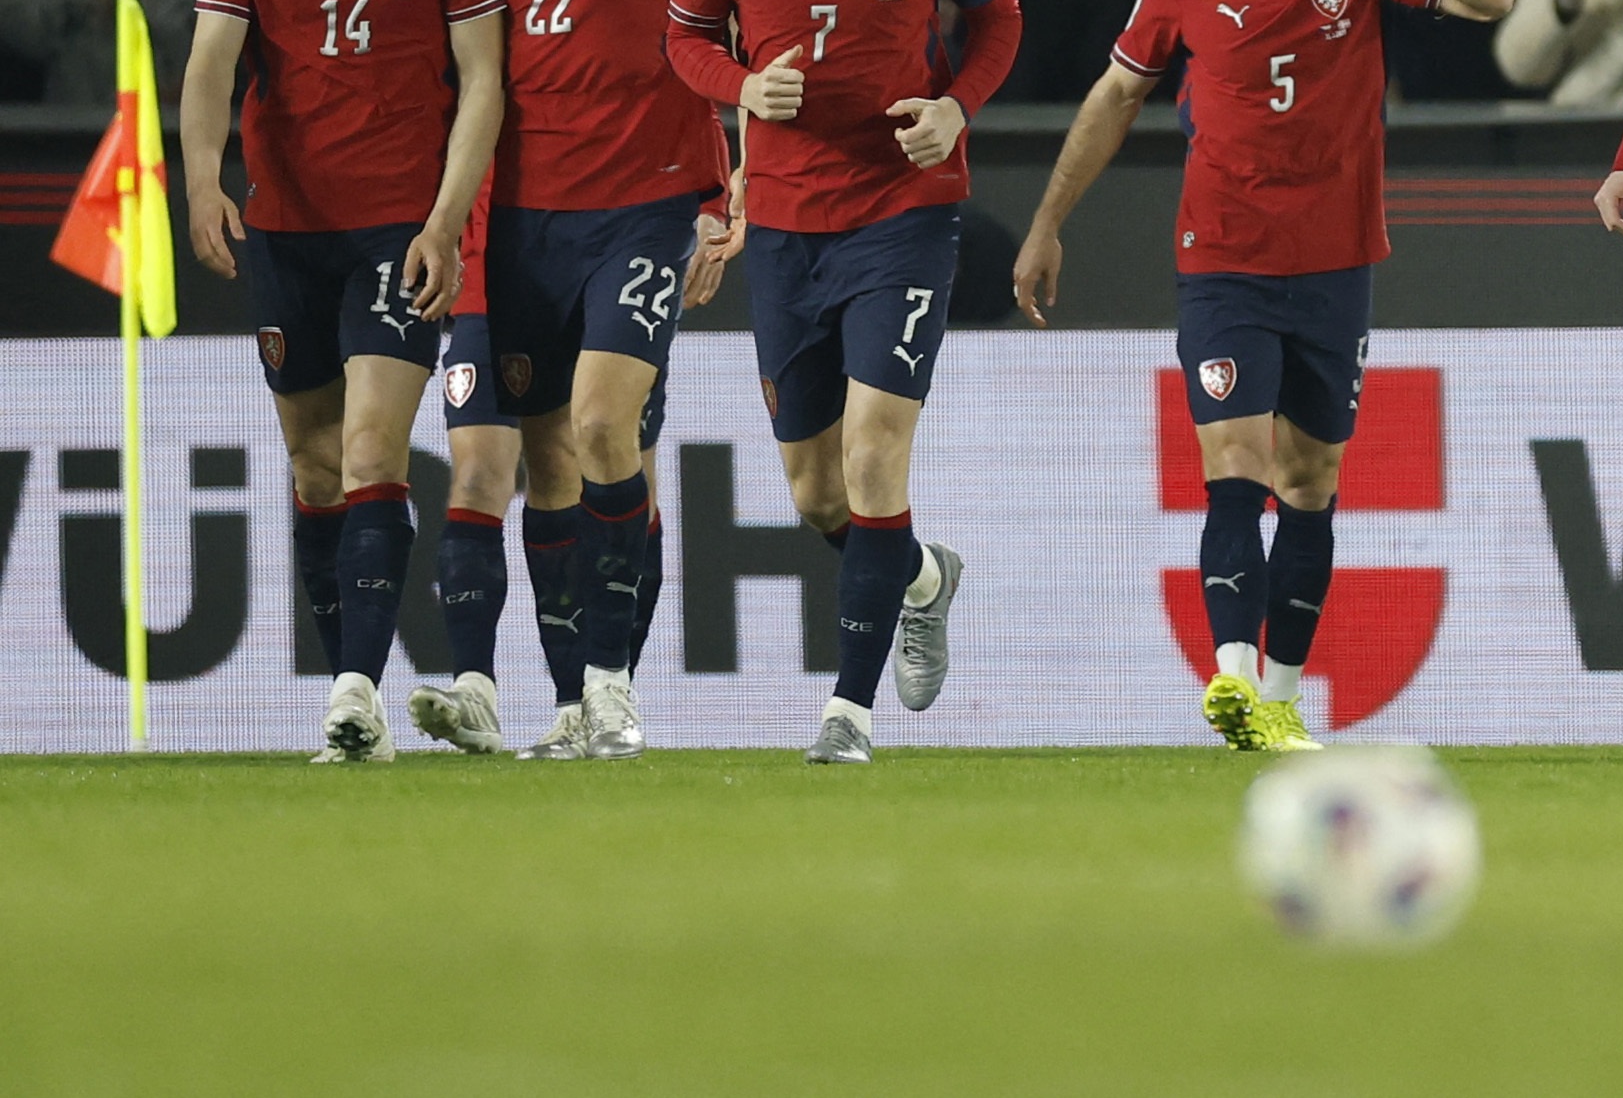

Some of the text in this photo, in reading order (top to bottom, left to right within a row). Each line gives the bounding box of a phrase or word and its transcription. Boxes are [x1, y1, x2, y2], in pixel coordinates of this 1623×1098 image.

[811, 5, 838, 62] 7
[1270, 53, 1296, 112] 5
[618, 256, 676, 320] 22
[902, 286, 934, 343] 7
[446, 590, 485, 604] CZE
[840, 617, 873, 632] CZE
